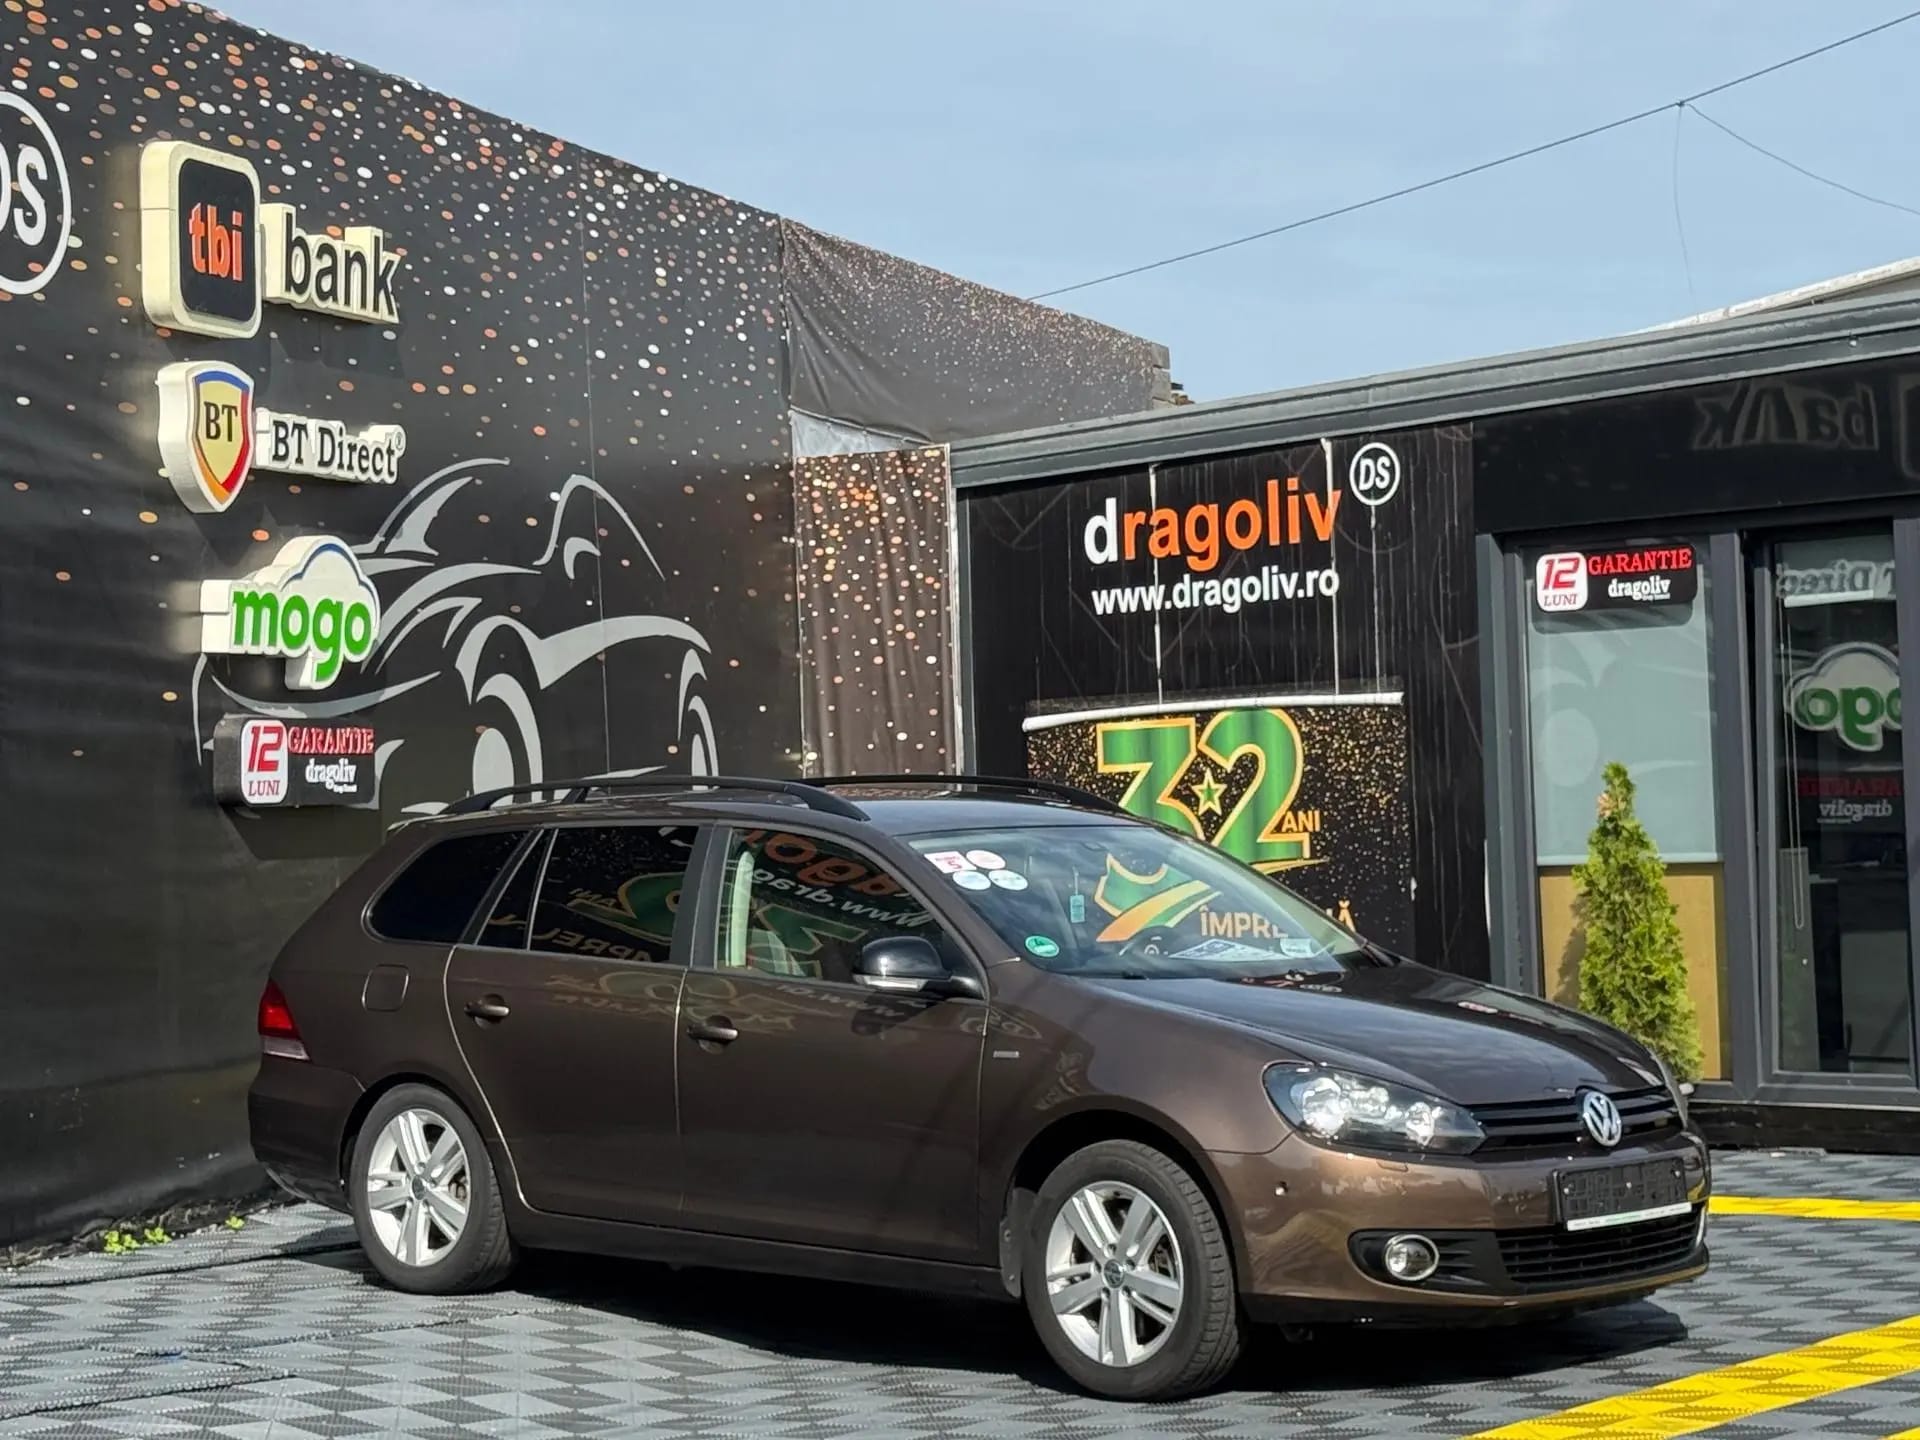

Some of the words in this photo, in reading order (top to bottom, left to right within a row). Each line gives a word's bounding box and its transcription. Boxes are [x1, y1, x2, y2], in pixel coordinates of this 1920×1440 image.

[188, 201, 245, 282] tbi
[285, 211, 398, 316] bank
[203, 400, 239, 443] BT
[272, 419, 309, 466] BT
[317, 425, 396, 479] Direct
[1358, 455, 1391, 491] DS
[1083, 477, 1343, 572] dragoliv
[1091, 564, 1341, 616] www.dragoliv.ro
[1543, 557, 1581, 591] 12
[1588, 548, 1693, 576] GARANTIE
[1607, 575, 1672, 601] dragoliv
[1543, 594, 1578, 607] LUNI
[232, 589, 372, 684] mogo
[247, 726, 284, 772] 12
[288, 726, 375, 755] GARANTIE
[248, 779, 280, 797] LUNI
[305, 757, 358, 790] dragoliv
[1095, 706, 1310, 918] 32
[1281, 809, 1320, 833] ANI
